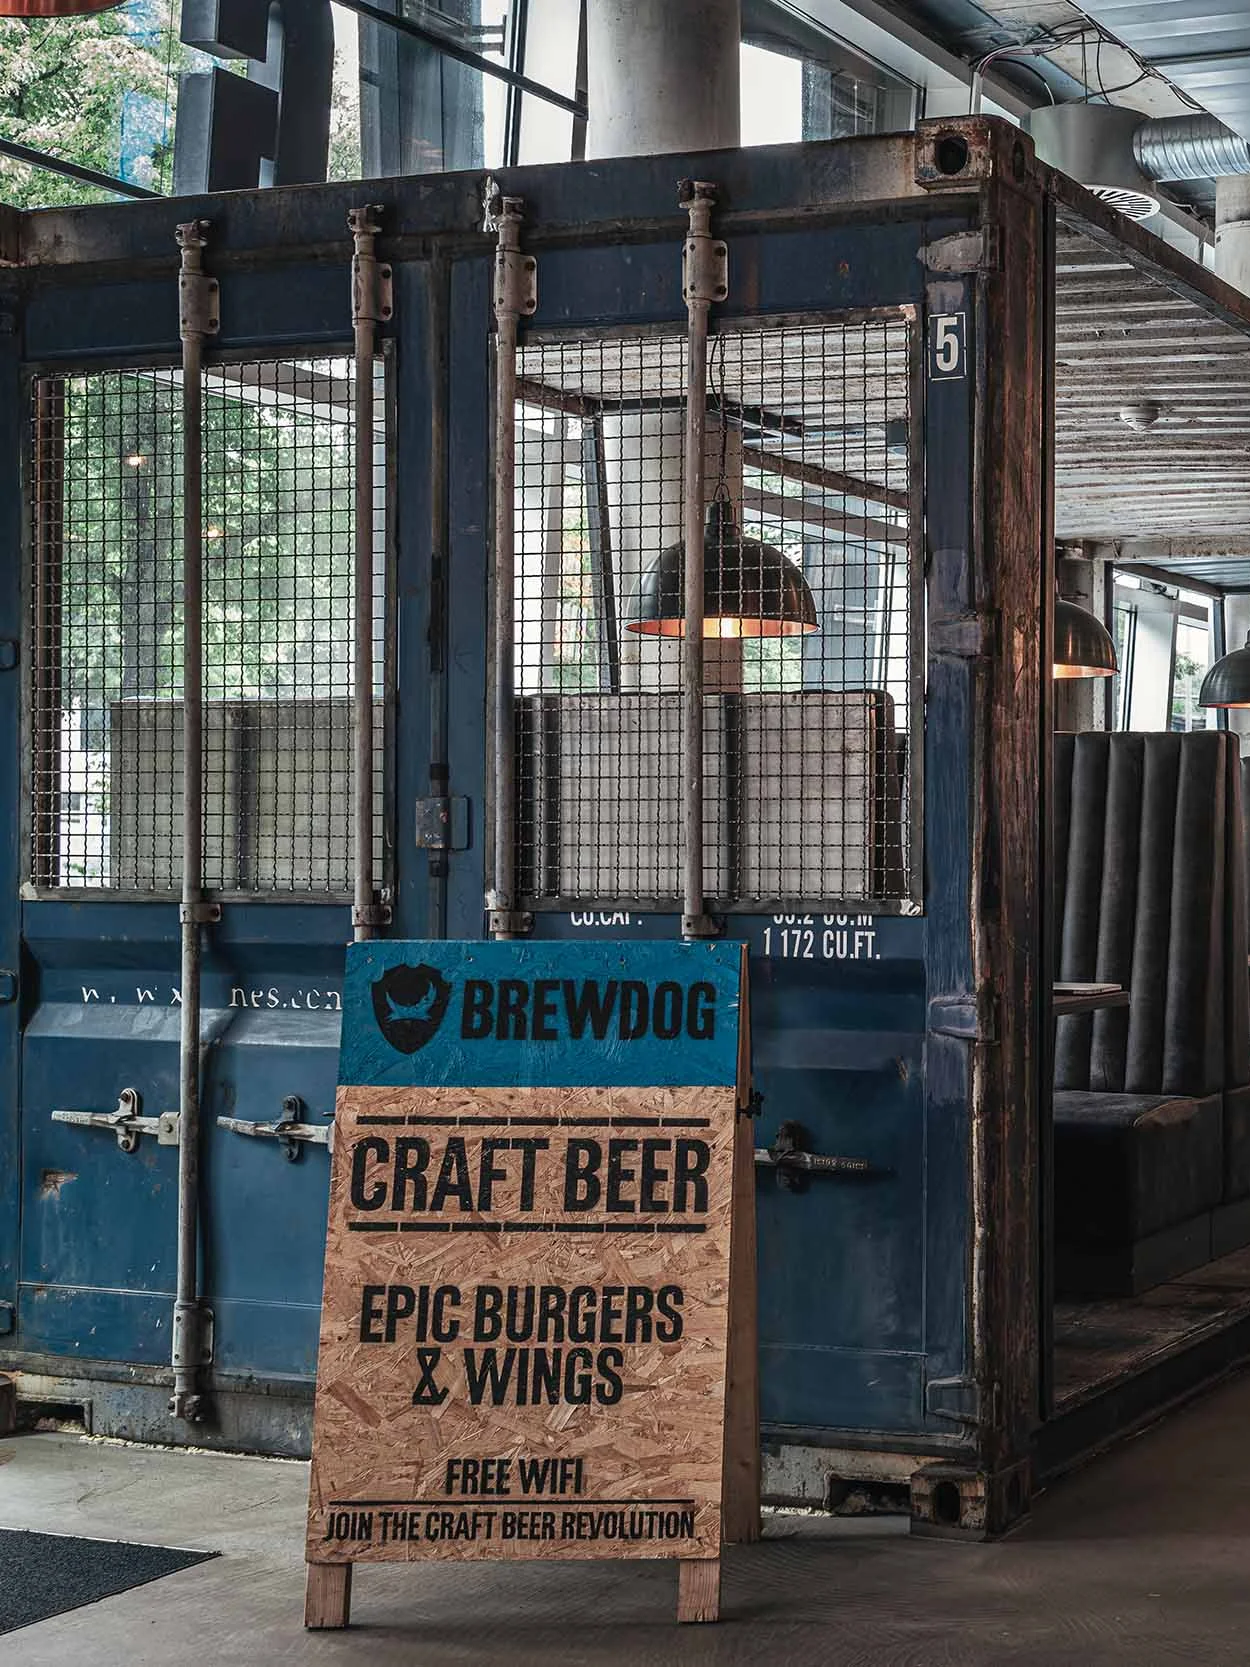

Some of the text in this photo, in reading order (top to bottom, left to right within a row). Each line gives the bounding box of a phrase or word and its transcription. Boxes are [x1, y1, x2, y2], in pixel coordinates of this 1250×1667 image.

[936, 316, 959, 372] 5
[823, 930, 882, 960] CU.FT.
[461, 979, 717, 1041] BREWDOG
[350, 1136, 710, 1212] CRAFT BEER
[359, 1285, 684, 1343] EPIC BURGERS
[412, 1347, 624, 1405] & WINGS
[445, 1457, 583, 1495] FREE WIFI
[323, 1511, 695, 1541] JOIN THE CRAFT BEER REVOLUTION
